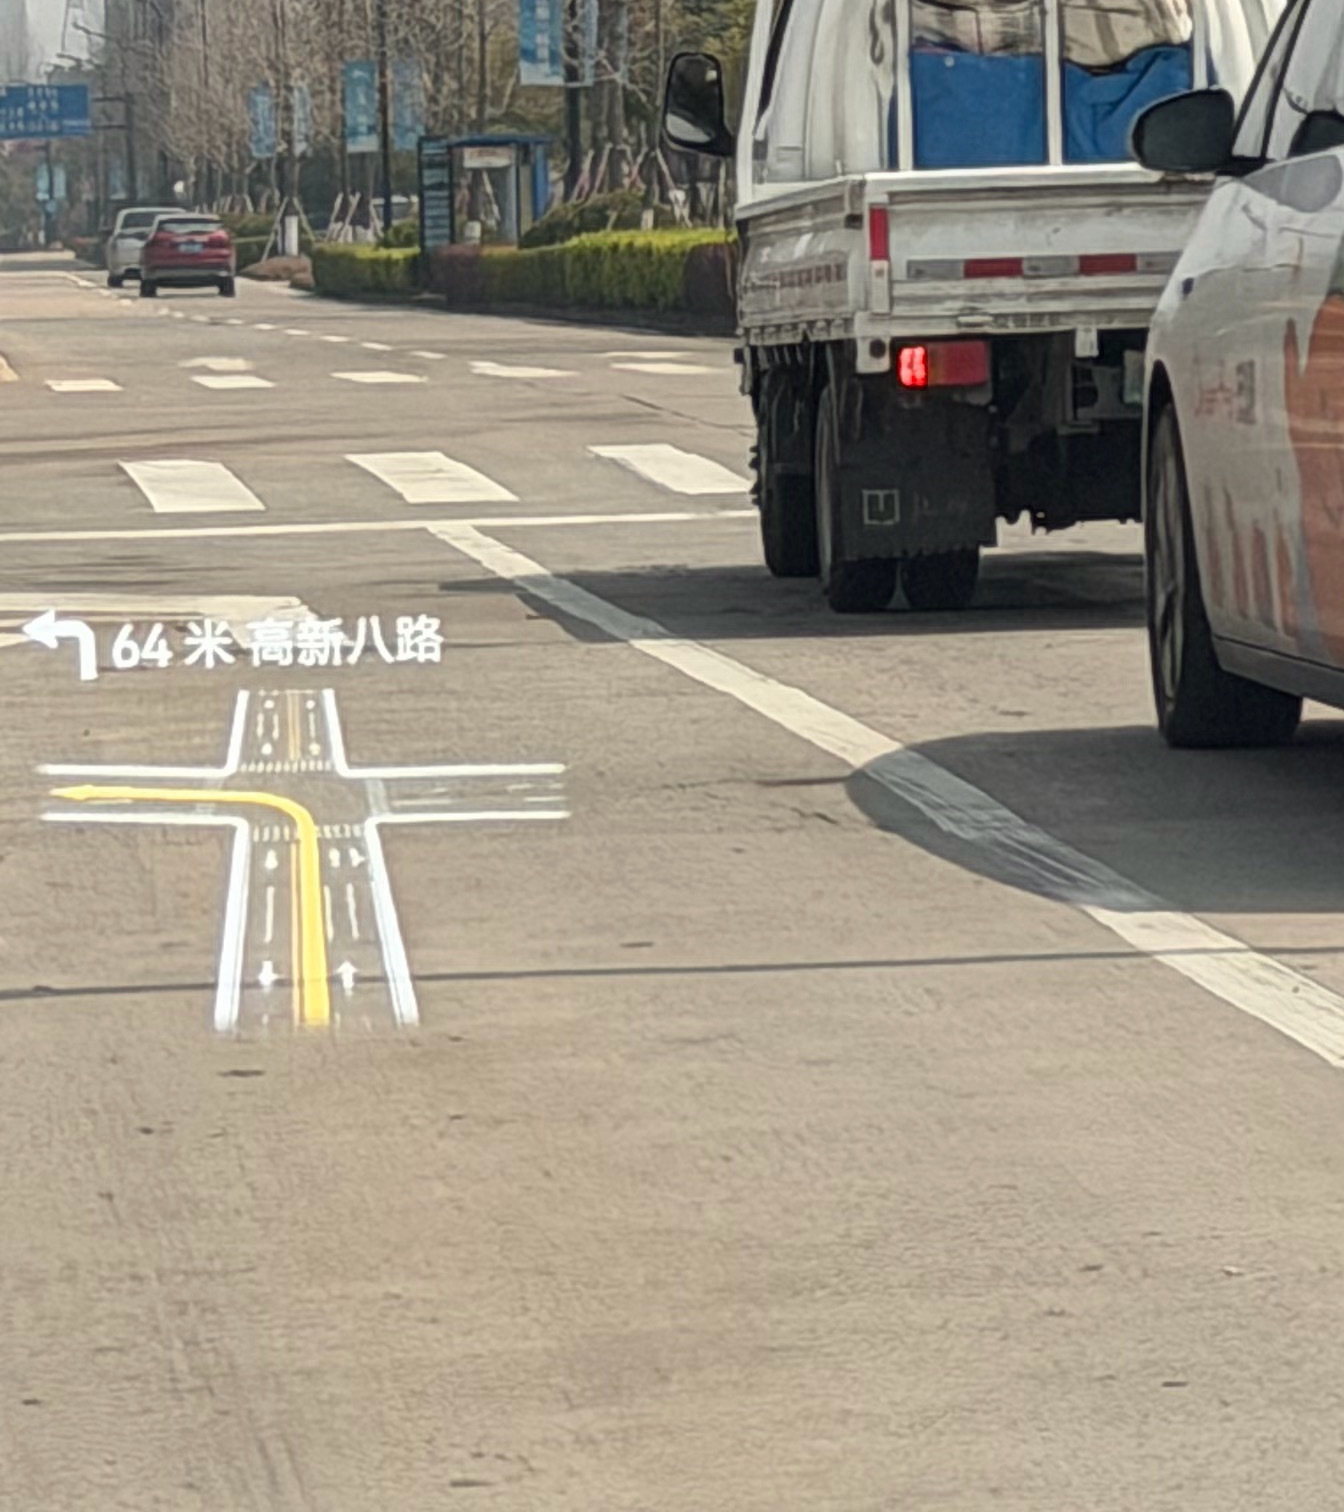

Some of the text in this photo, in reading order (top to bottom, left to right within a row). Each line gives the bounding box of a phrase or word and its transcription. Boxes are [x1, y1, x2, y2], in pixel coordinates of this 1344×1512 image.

[112, 614, 444, 668] 64 米 高新八路
